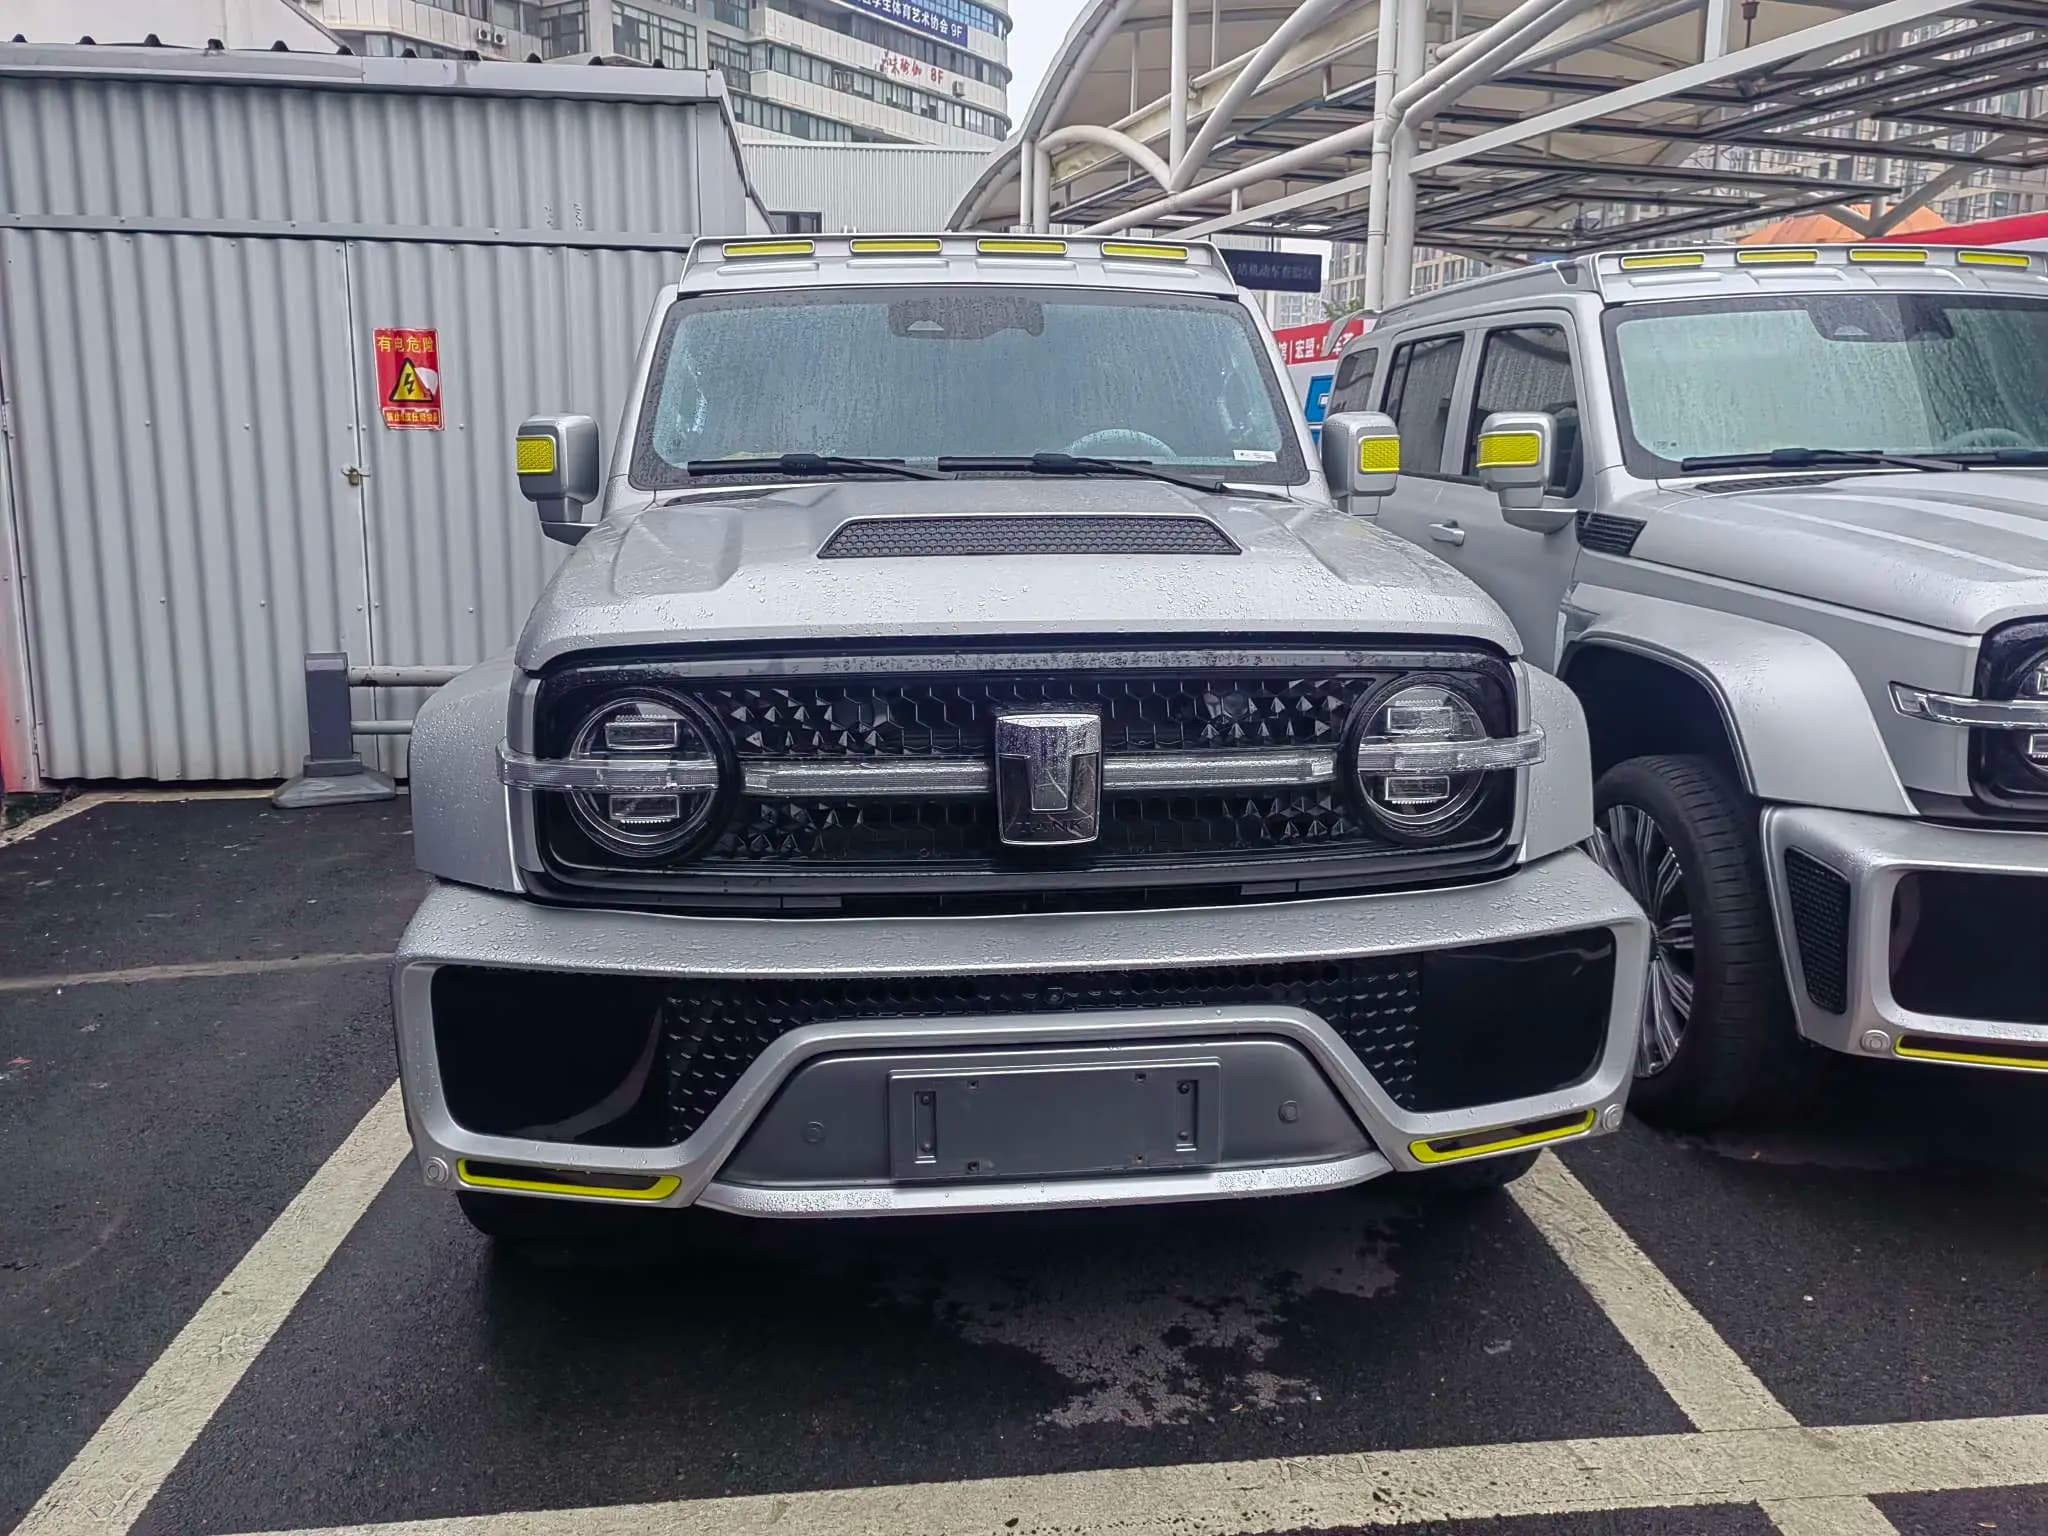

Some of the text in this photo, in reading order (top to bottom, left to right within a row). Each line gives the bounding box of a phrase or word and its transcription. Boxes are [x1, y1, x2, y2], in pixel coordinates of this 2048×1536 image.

[951, 23, 963, 38] 9F
[930, 68, 945, 85] 8F
[376, 335, 435, 353] 有电危险
